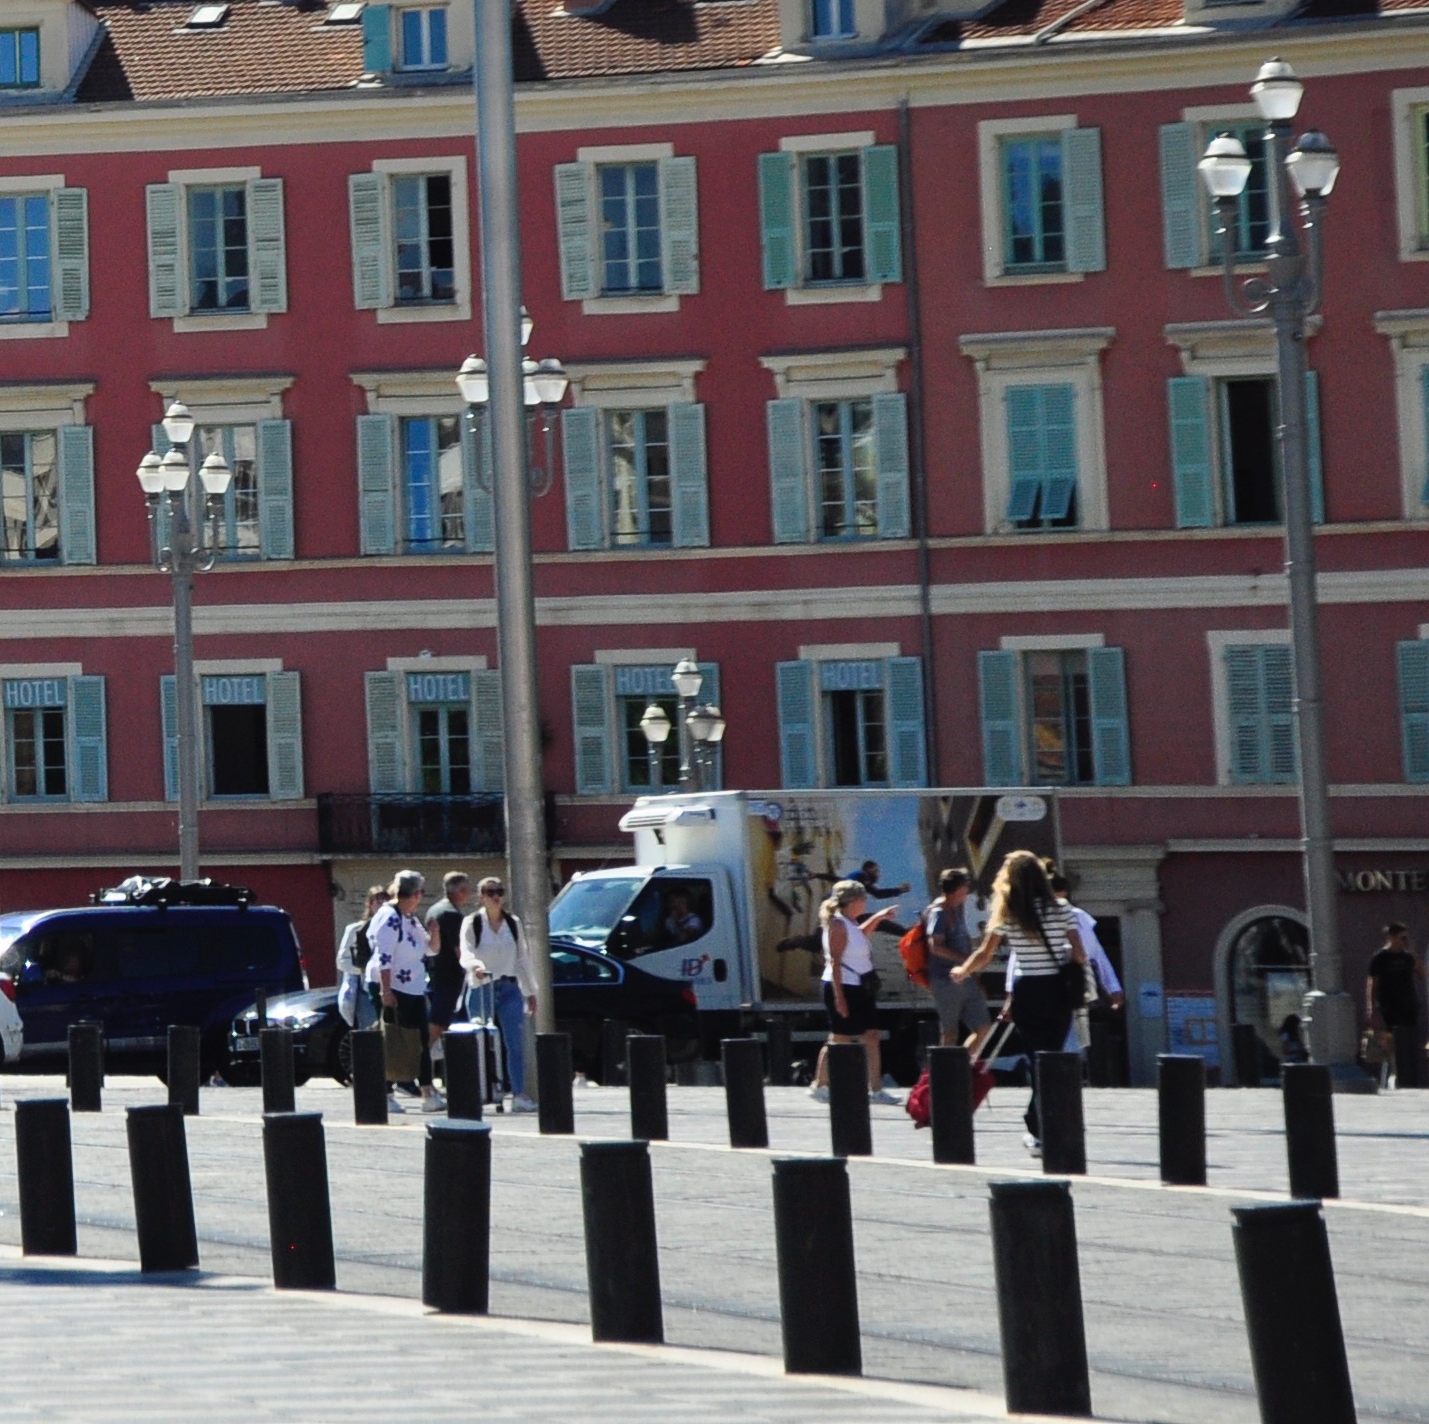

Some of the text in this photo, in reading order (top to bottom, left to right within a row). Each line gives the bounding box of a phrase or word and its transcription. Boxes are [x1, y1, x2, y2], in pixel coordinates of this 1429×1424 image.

[6, 680, 64, 706] HOTEL
[205, 678, 264, 704] HOTEL
[409, 674, 469, 701] HOTEL
